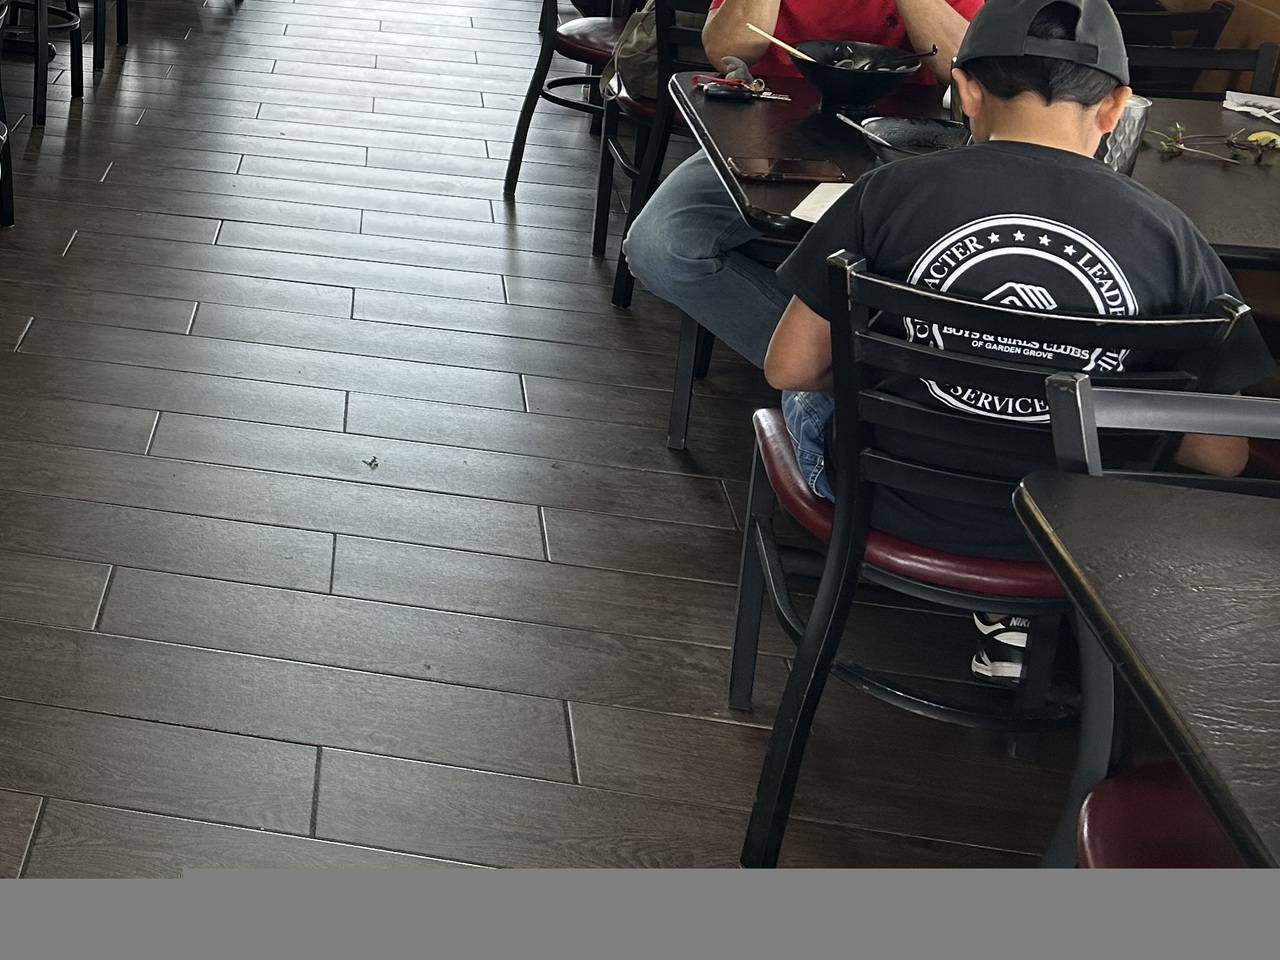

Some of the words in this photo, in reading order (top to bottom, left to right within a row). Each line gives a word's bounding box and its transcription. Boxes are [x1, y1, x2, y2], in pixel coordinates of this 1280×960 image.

[923, 235, 985, 291] ACTER
[971, 339, 984, 348] OF
[985, 342, 1021, 354] GARDEN
[1022, 348, 1054, 360] GROVE
